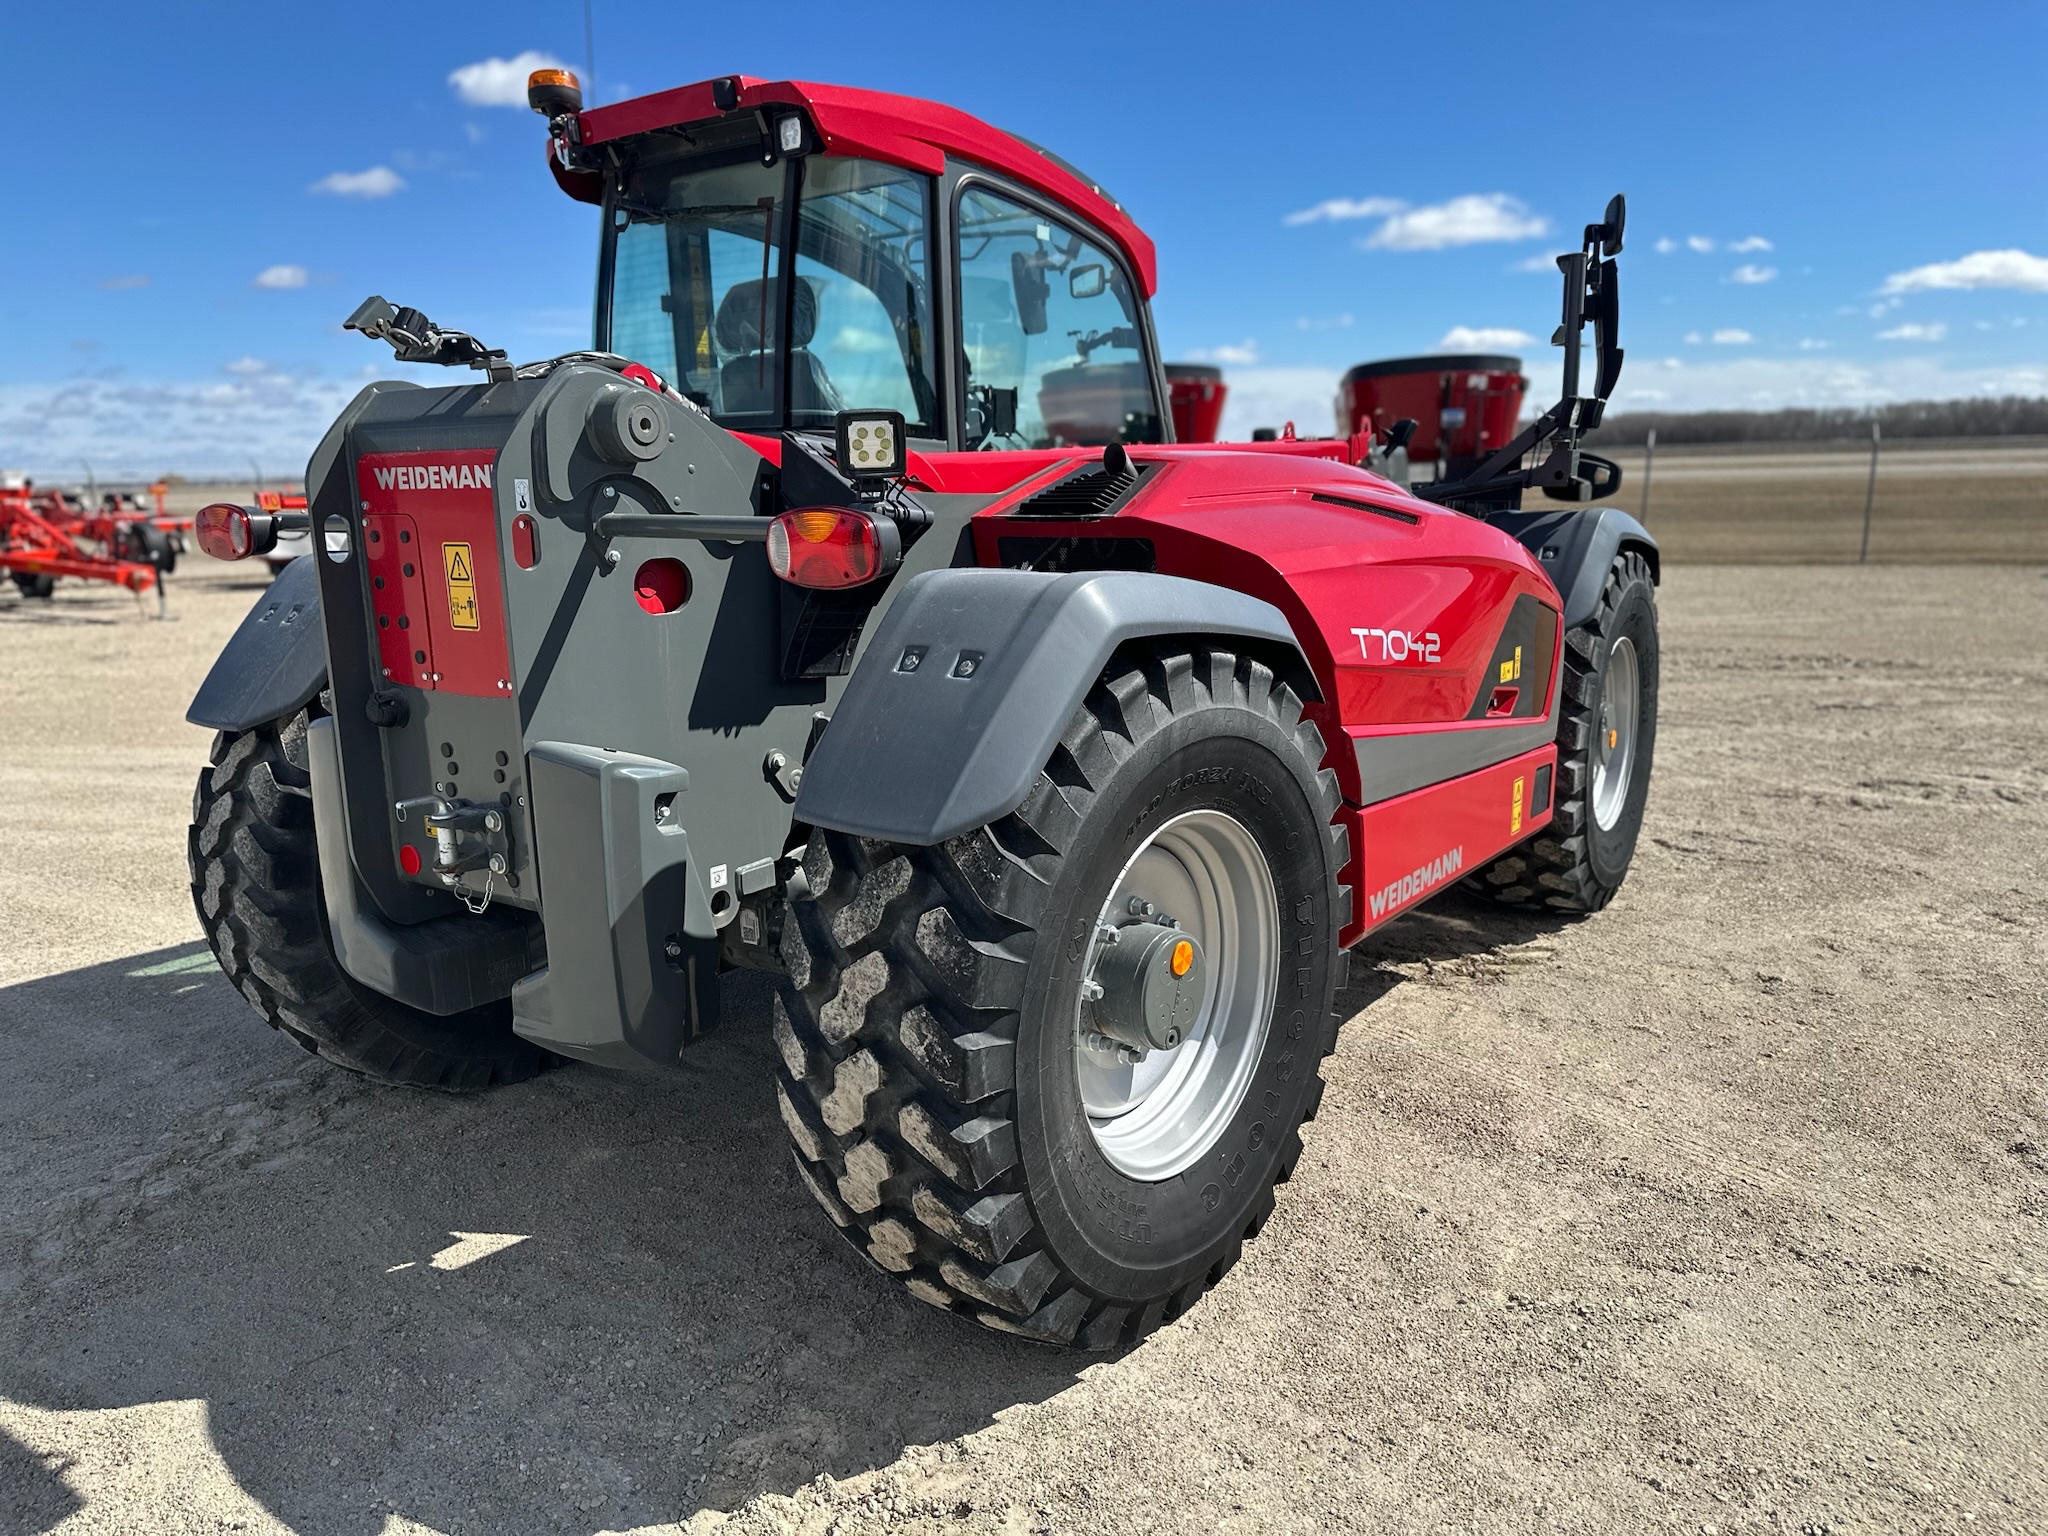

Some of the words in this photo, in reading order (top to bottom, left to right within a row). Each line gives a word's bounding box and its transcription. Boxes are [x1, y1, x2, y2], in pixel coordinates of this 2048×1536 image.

[374, 464, 493, 490] WEIDEMAN
[1350, 627, 1441, 662] T7042
[1369, 845, 1462, 920] WEIDEMANN
